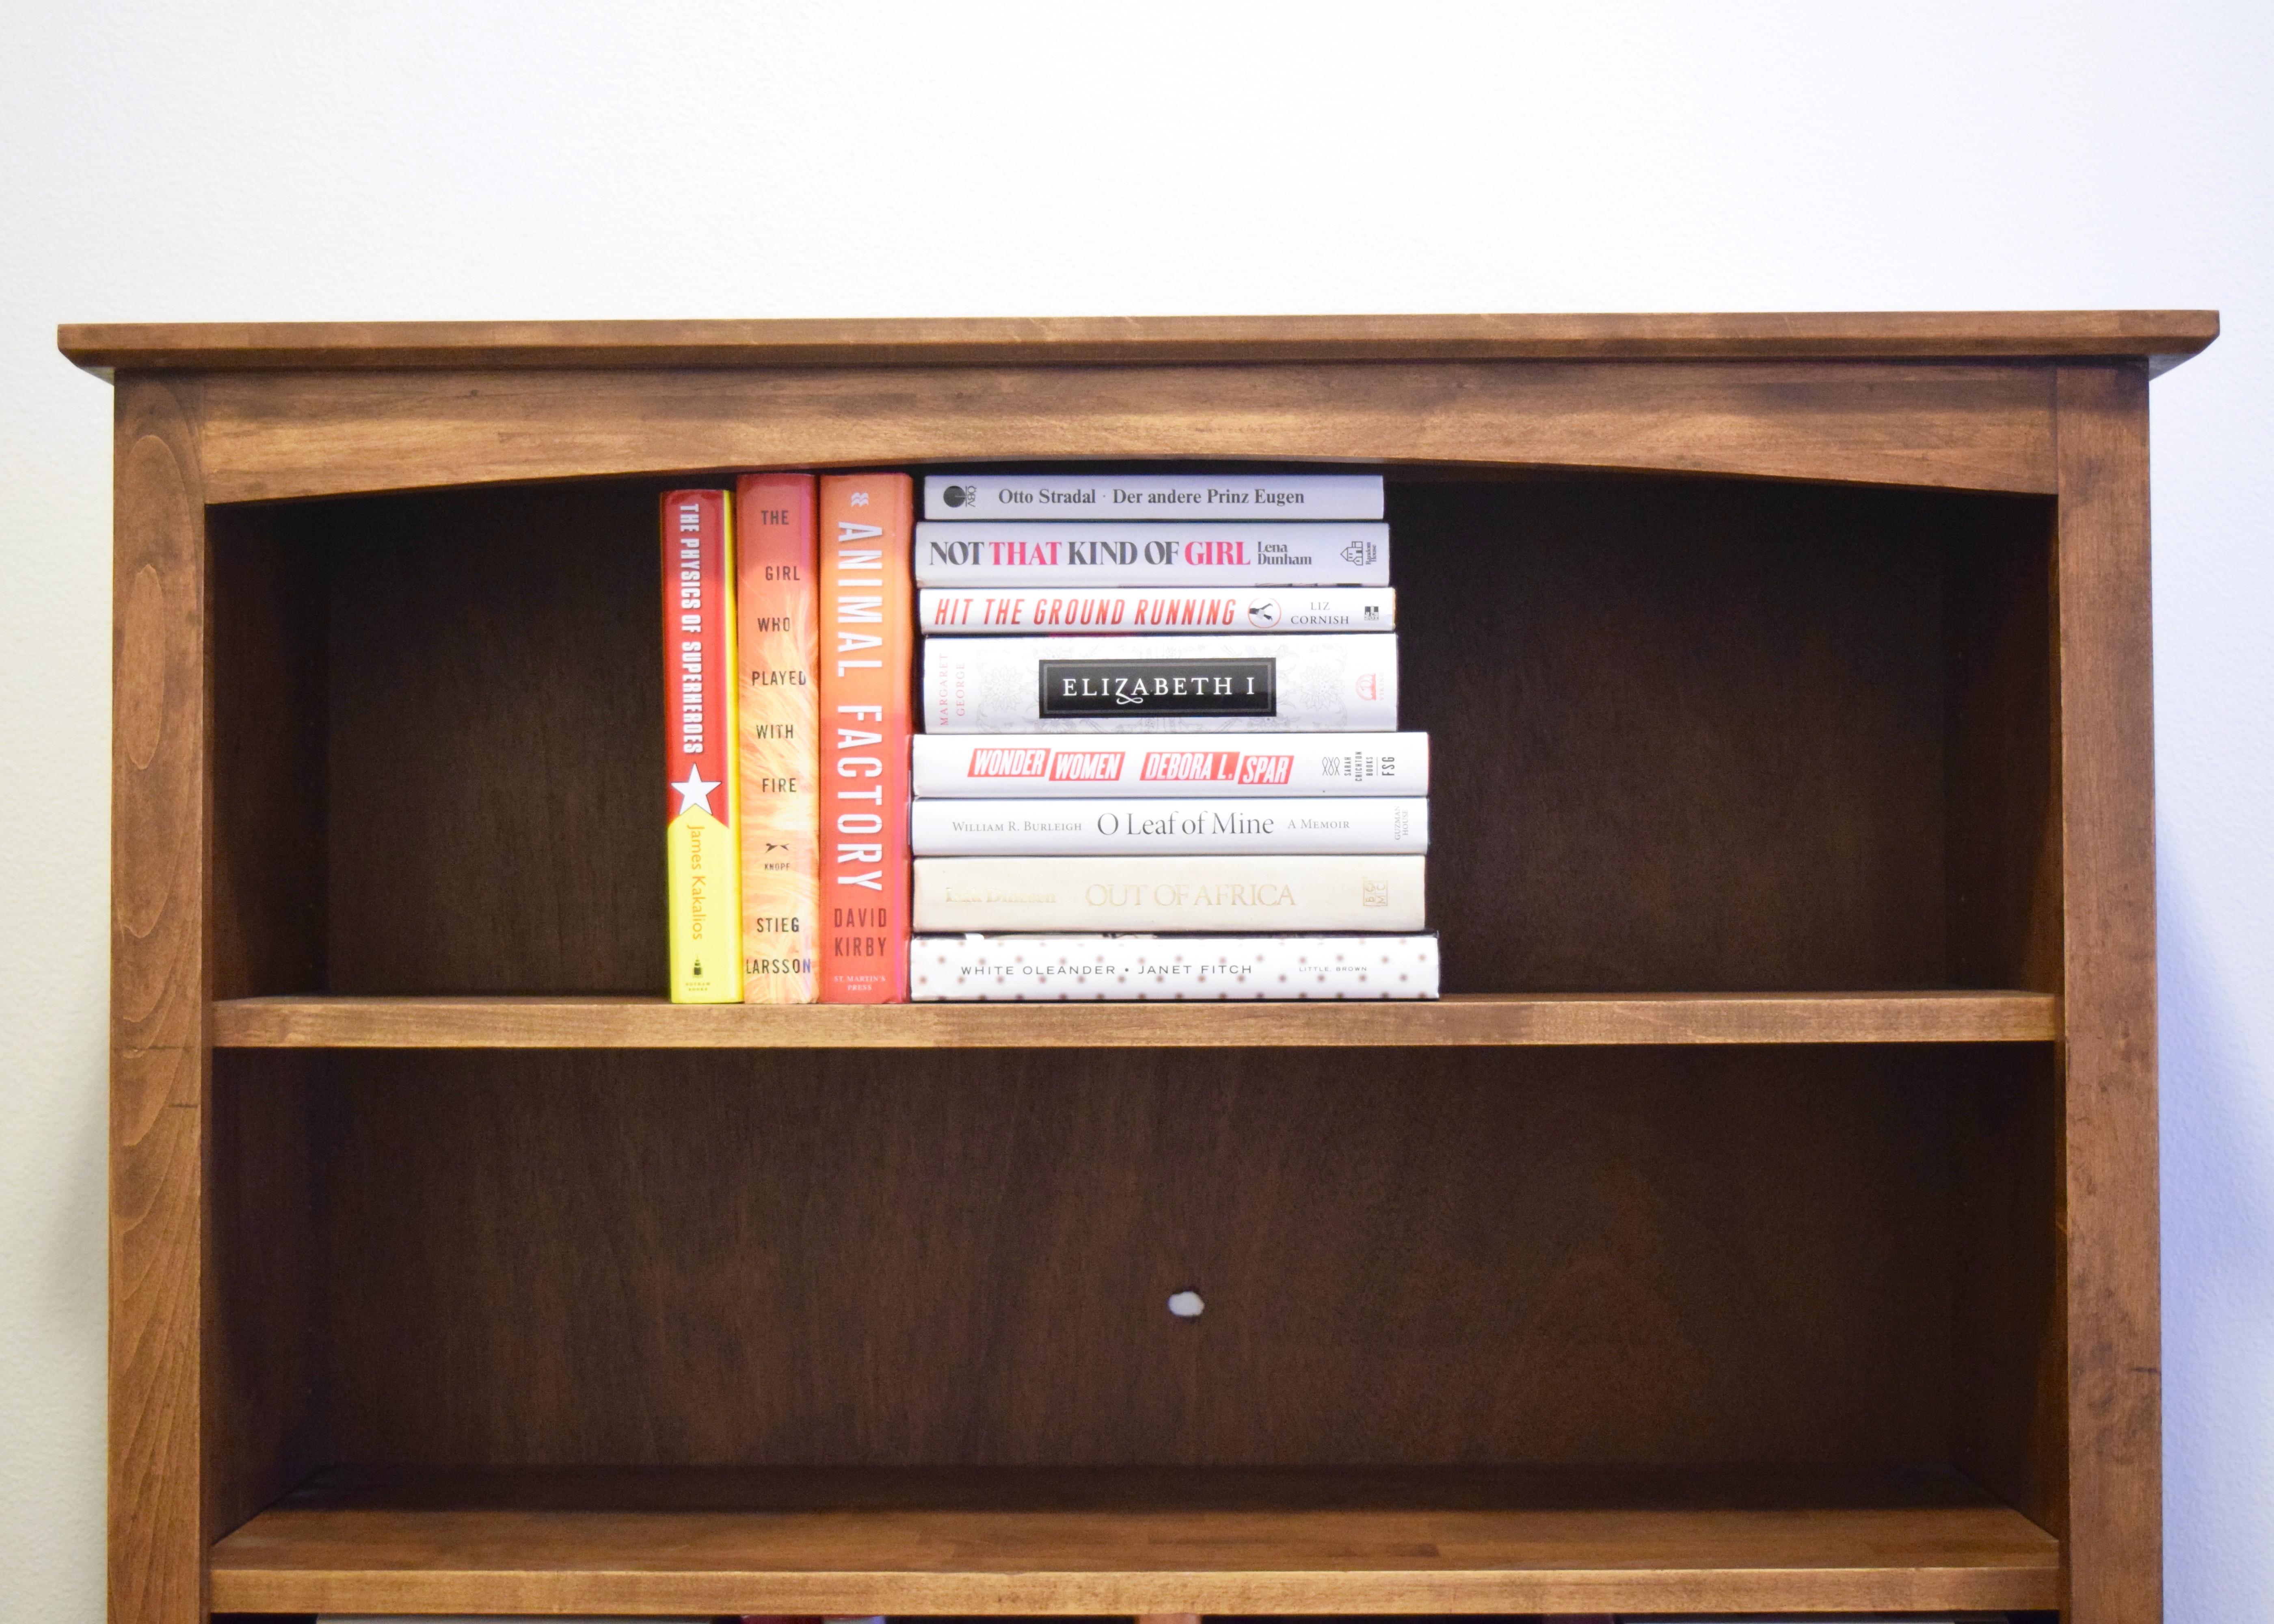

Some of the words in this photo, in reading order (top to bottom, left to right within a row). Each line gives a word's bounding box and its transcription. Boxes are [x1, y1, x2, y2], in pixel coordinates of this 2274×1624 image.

[999, 489, 1033, 504] Otto
[1039, 488, 1096, 504] Stradal
[1113, 489, 1143, 504] Der
[1148, 488, 1202, 504] andere
[1207, 489, 1249, 504] Prinz
[1254, 489, 1305, 507] Eugen
[681, 503, 699, 532] THE
[761, 510, 789, 525] THE
[929, 541, 985, 566] NOT
[989, 542, 1062, 566] THAT
[1068, 542, 1138, 566] KIND
[1144, 541, 1180, 566] OF
[1185, 541, 1251, 566] GIRL
[1258, 542, 1288, 553] Lena
[1258, 553, 1312, 565] Dunham
[681, 538, 701, 609] PHYSICS
[765, 566, 800, 581] GIRL
[838, 521, 882, 677] ANIMAL
[1310, 602, 1330, 611] LIZ
[935, 599, 973, 625] HIT
[984, 599, 1025, 625] THE
[1033, 599, 1126, 625] GROUND
[1134, 599, 1236, 625] RUNNING
[1291, 616, 1349, 624] CORNISH
[682, 615, 701, 633] OF
[758, 617, 791, 632] WHO
[752, 671, 806, 686] PLAYED
[682, 641, 703, 754] SUPERHEROES
[940, 653, 949, 726] MARGARET
[956, 663, 965, 716] GEORGE
[1063, 677, 1232, 704] ELIZABETH
[1247, 677, 1255, 695] I
[757, 725, 794, 739] WITH
[974, 749, 1045, 776] WONDER
[1055, 753, 1122, 780] WOMEN
[1145, 753, 1217, 779] DEBORA
[1217, 754, 1233, 779] L.
[1244, 756, 1291, 783] SPAR
[1382, 757, 1395, 776] FSG
[763, 778, 797, 793] FIRE
[837, 705, 882, 891] FACTORY
[1009, 821, 1020, 831] R.
[1097, 812, 1119, 836] O
[1127, 811, 1179, 835] Leaf
[1182, 811, 1208, 835] of
[1213, 812, 1274, 834] Mine
[1288, 820, 1297, 829] A
[687, 825, 702, 870] James
[765, 863, 790, 871] KNOPF
[1085, 884, 1148, 907] OUT
[1154, 884, 1191, 907] OF
[1194, 883, 1297, 907] AFRICA
[692, 875, 707, 940] Kakalios
[757, 918, 800, 933] STIEG
[834, 908, 887, 928] DAVID
[835, 937, 887, 957] KIRBY
[746, 959, 811, 974] LARSSON
[962, 965, 1014, 975] WHITE
[1022, 965, 1115, 975] OLEANDER
[1137, 965, 1192, 975] JANET
[1202, 965, 1252, 974] FITCH
